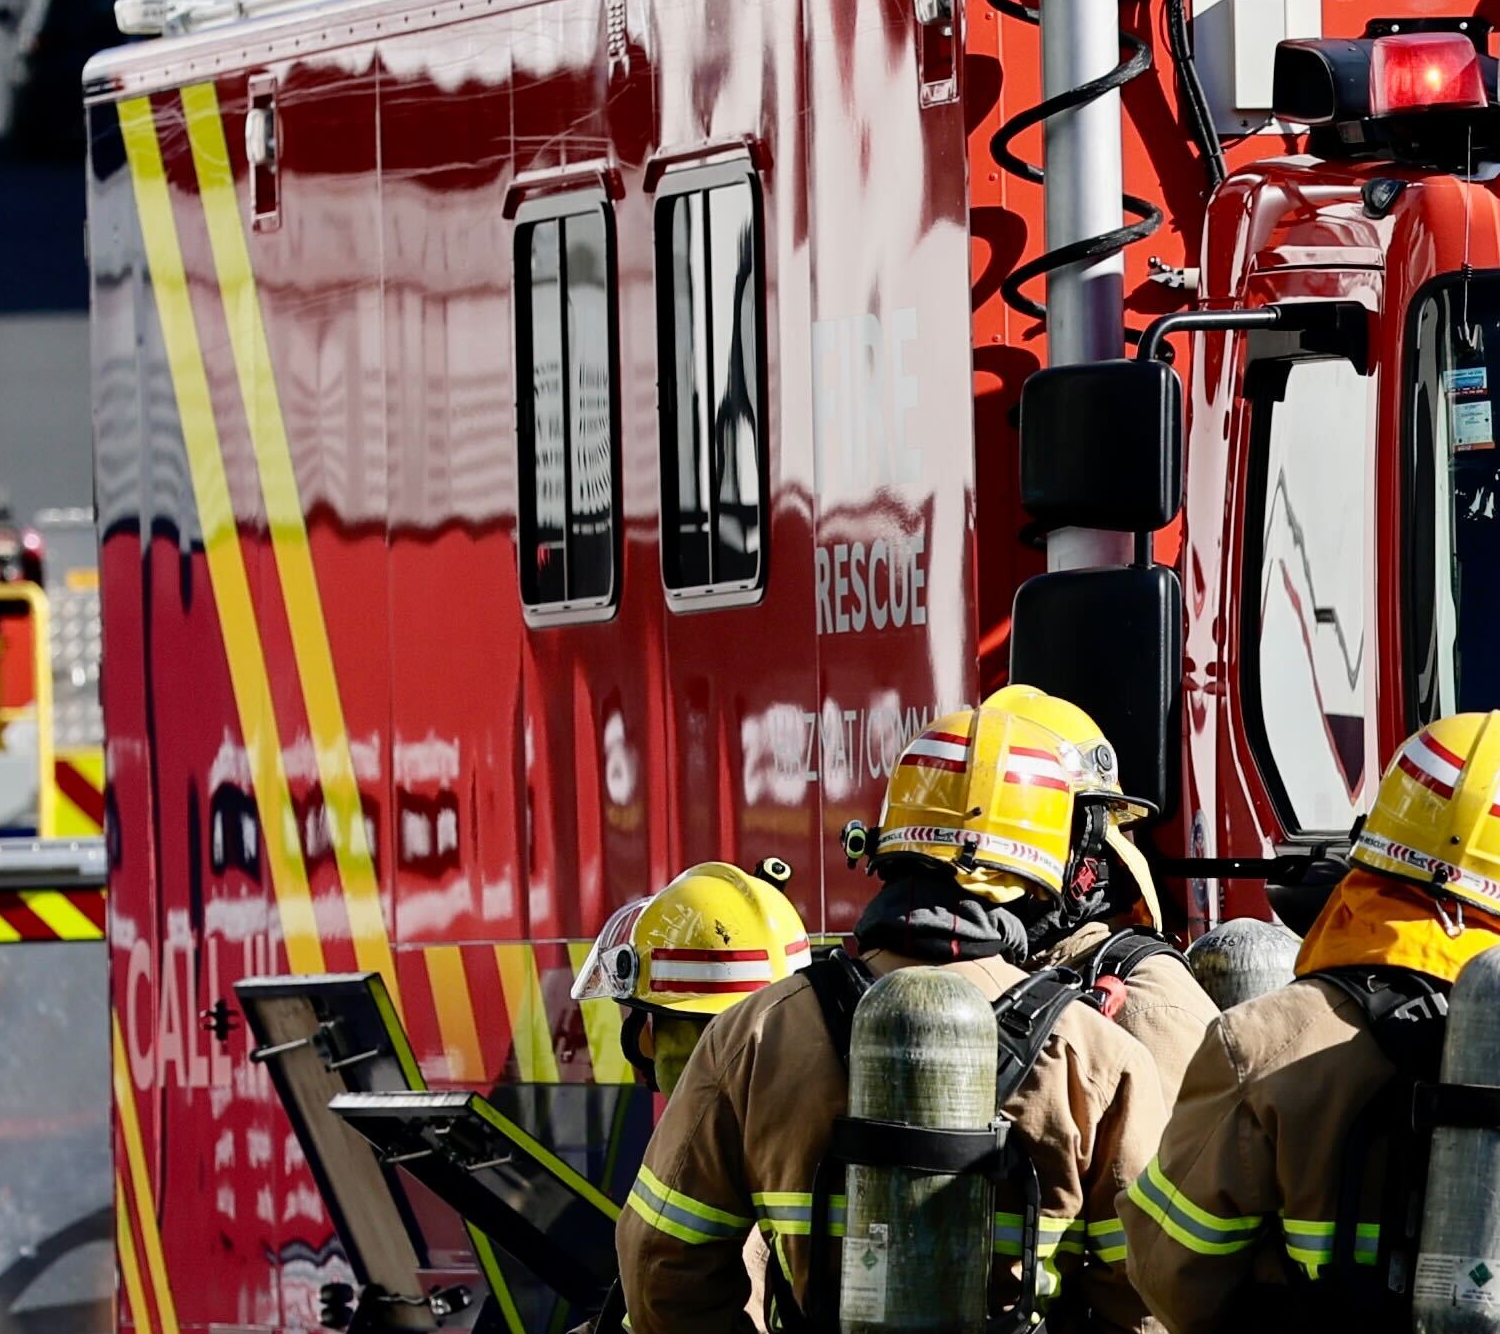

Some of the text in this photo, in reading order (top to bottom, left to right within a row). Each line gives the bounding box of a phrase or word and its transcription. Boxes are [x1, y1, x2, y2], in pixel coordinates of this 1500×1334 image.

[813, 306, 924, 496] FIRE
[815, 537, 928, 636] RESCUE
[126, 938, 233, 1091] CALL
